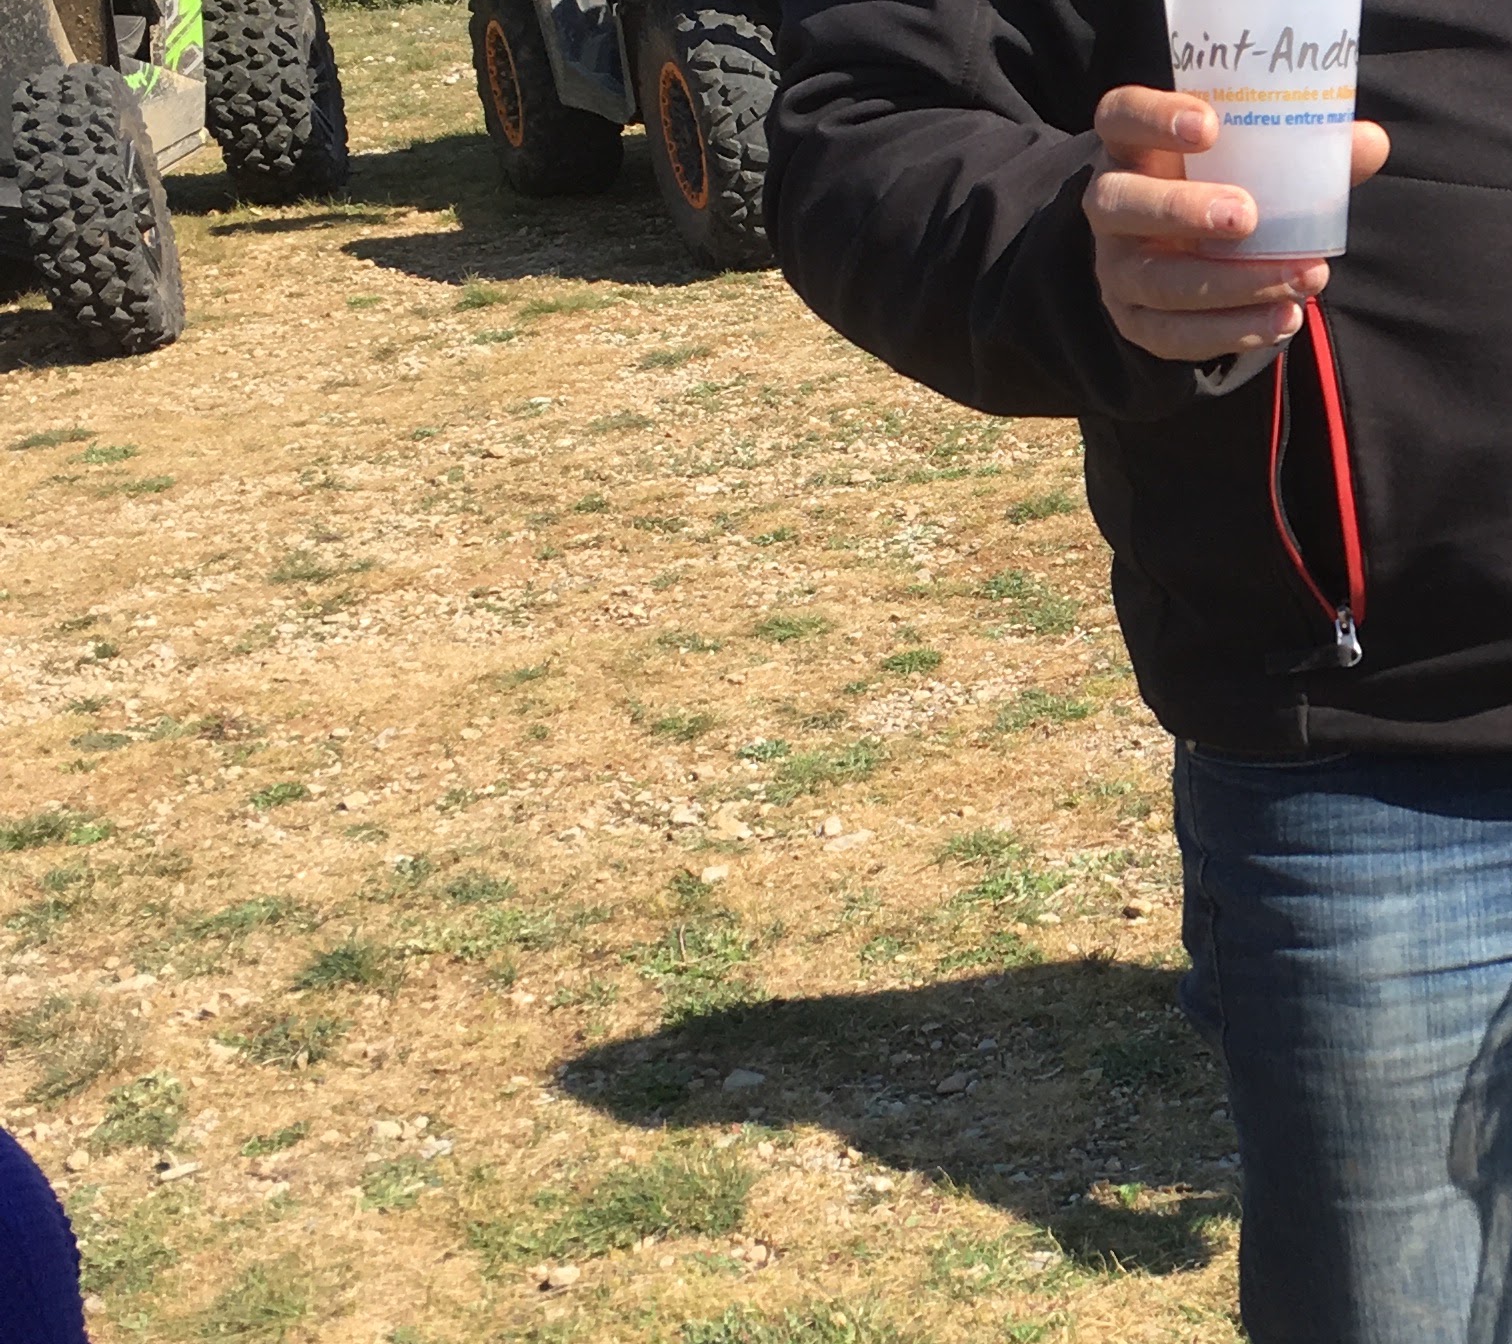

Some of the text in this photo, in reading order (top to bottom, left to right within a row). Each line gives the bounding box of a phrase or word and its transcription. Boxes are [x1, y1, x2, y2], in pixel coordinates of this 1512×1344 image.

[1213, 86, 1319, 102] Méditerranée
[1223, 111, 1281, 126] Andreu
[1285, 113, 1324, 125] entre
